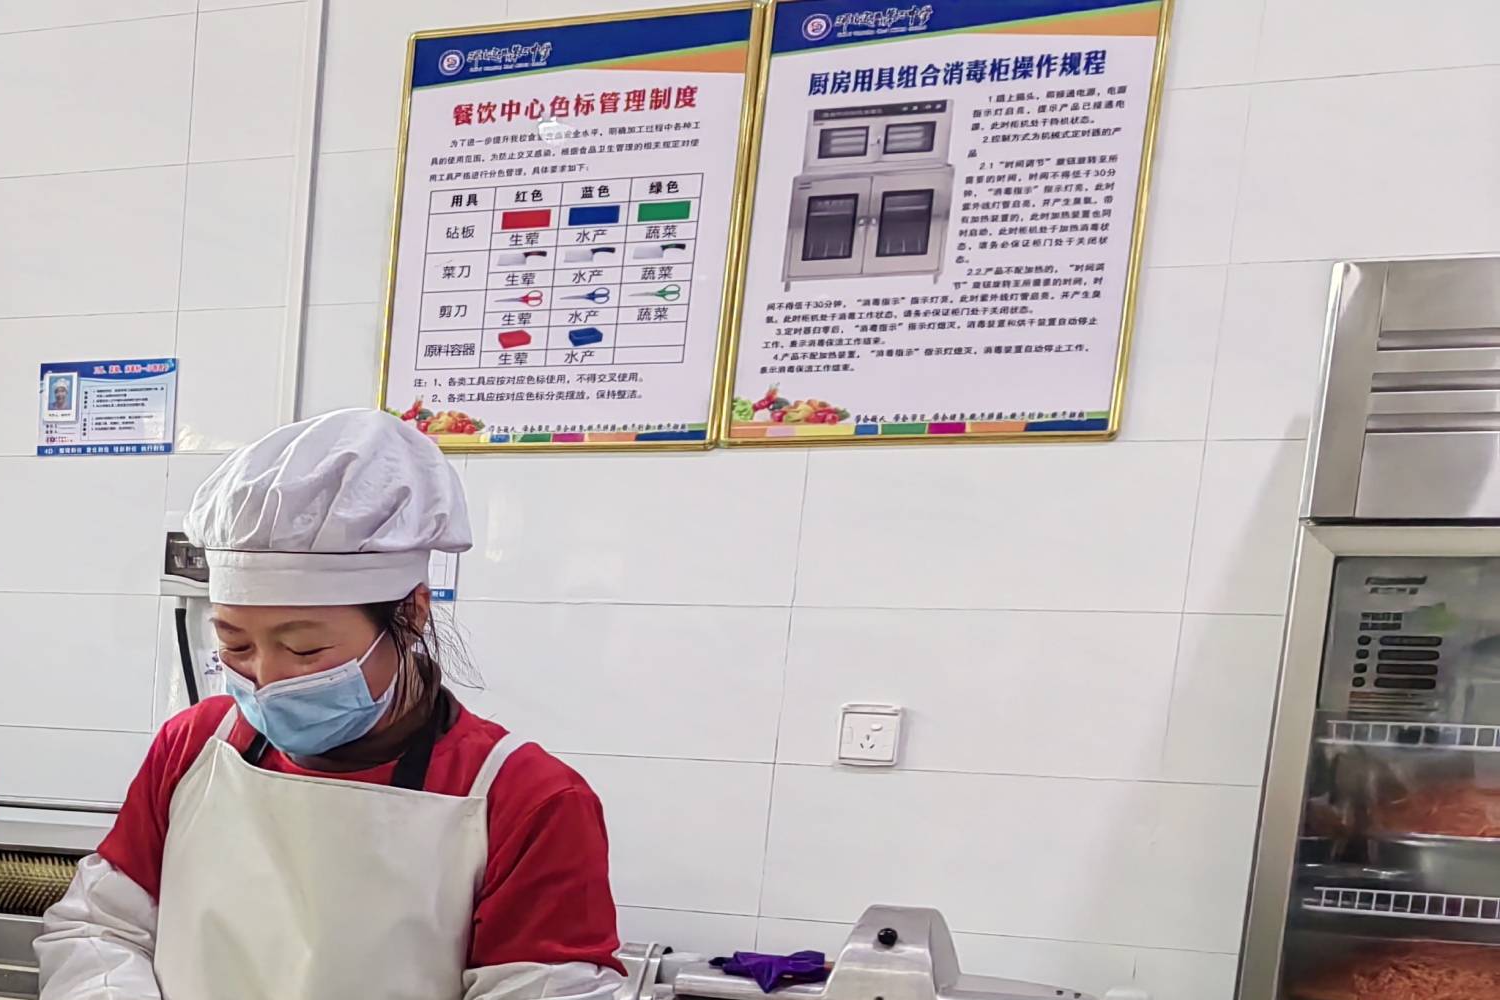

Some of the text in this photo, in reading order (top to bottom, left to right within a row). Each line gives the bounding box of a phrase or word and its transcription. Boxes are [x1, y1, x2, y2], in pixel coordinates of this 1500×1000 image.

[808, 50, 1106, 95] 厨房用具组合消毒柜操作规程
[453, 85, 698, 126] 餐饮中心色标管理制度
[451, 180, 679, 207] 用具 红色 蓝色 绿色
[445, 225, 677, 246] 砧板 生荤 水产 蔬菜
[442, 265, 673, 286] 菜刀 生荤 水产 蔬菜
[439, 304, 669, 326] 剪刀 生荤 水产 蔬菜
[424, 344, 595, 366] 原料容器 生荤 水产
